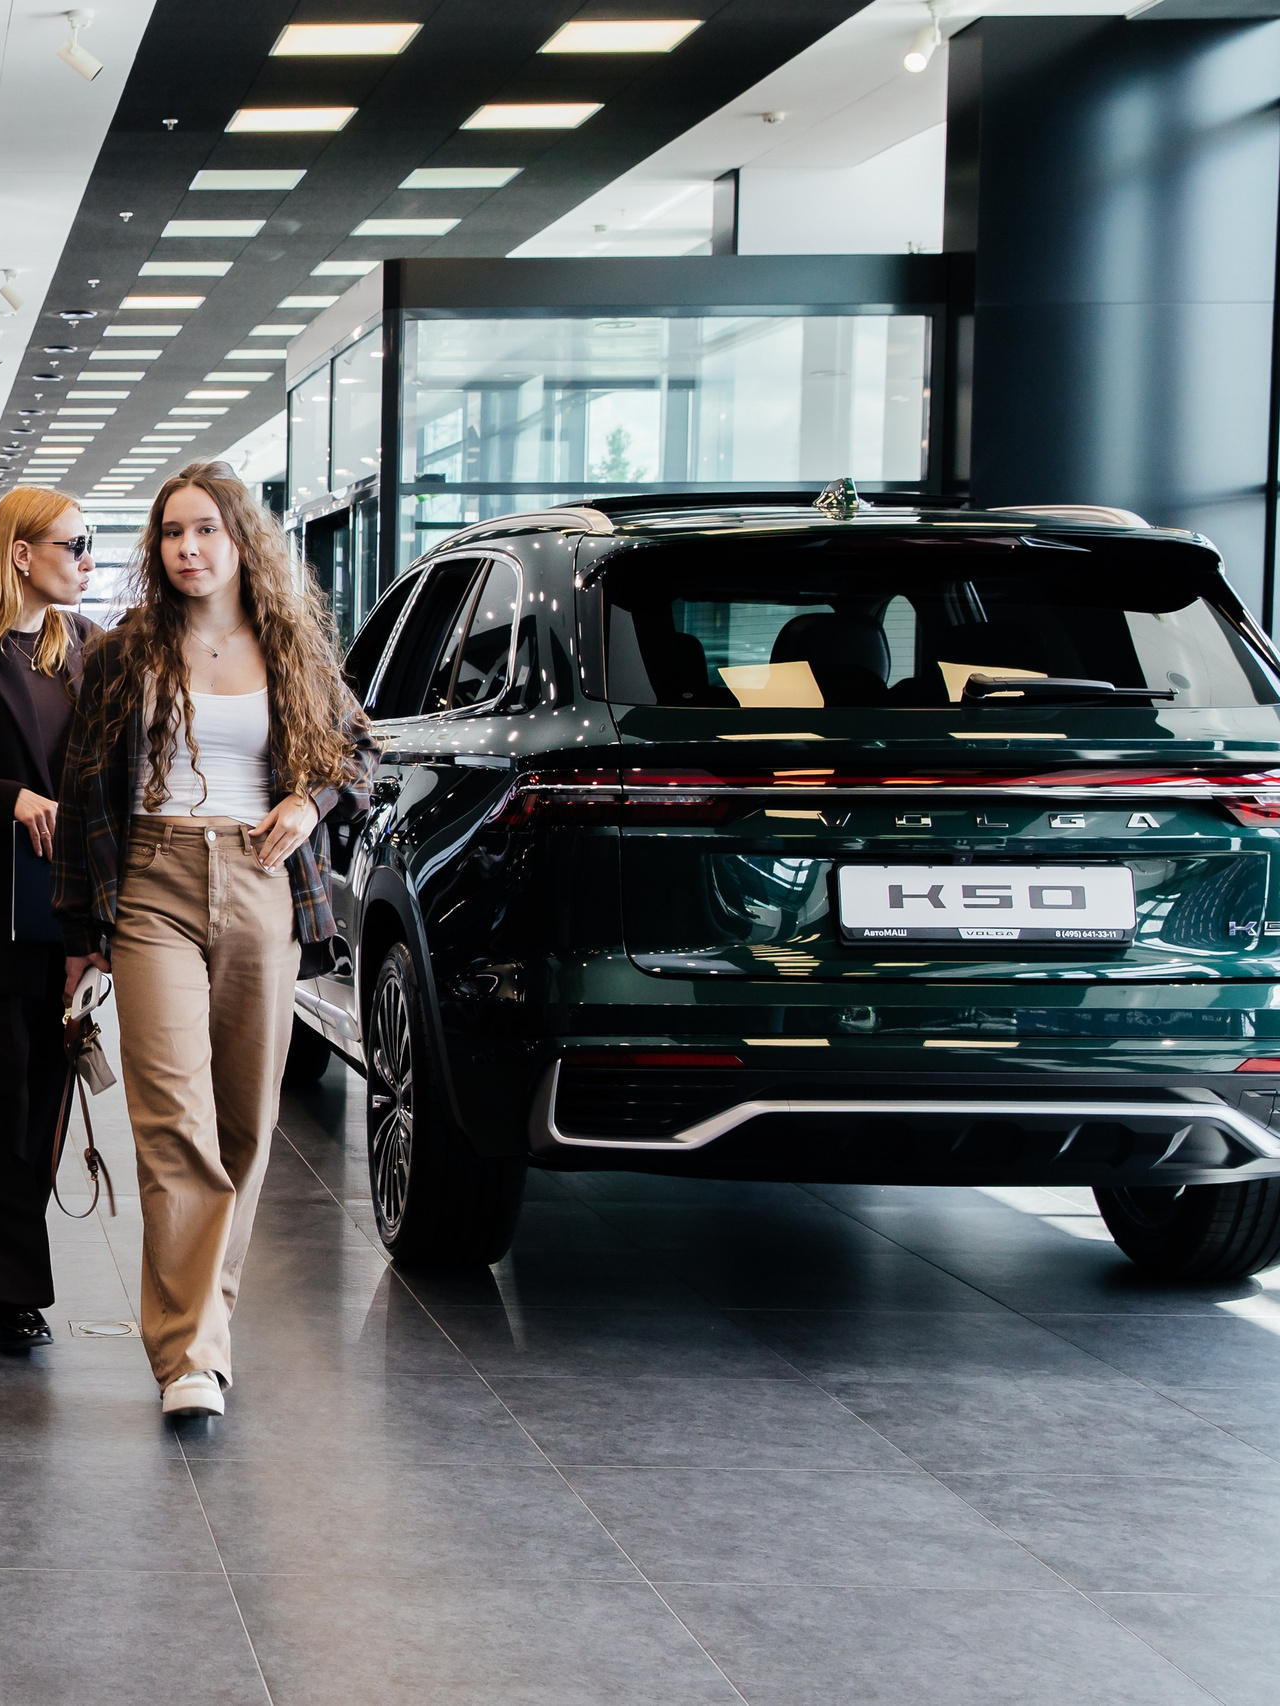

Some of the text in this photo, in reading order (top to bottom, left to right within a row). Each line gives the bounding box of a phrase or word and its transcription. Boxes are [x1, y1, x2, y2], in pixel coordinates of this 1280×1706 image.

[817, 812, 1161, 829] VOLGA
[887, 884, 1087, 909] K50
[863, 928, 908, 937] АвтоМАШ
[1055, 930, 1117, 939] 8 (495) 641-33-11
